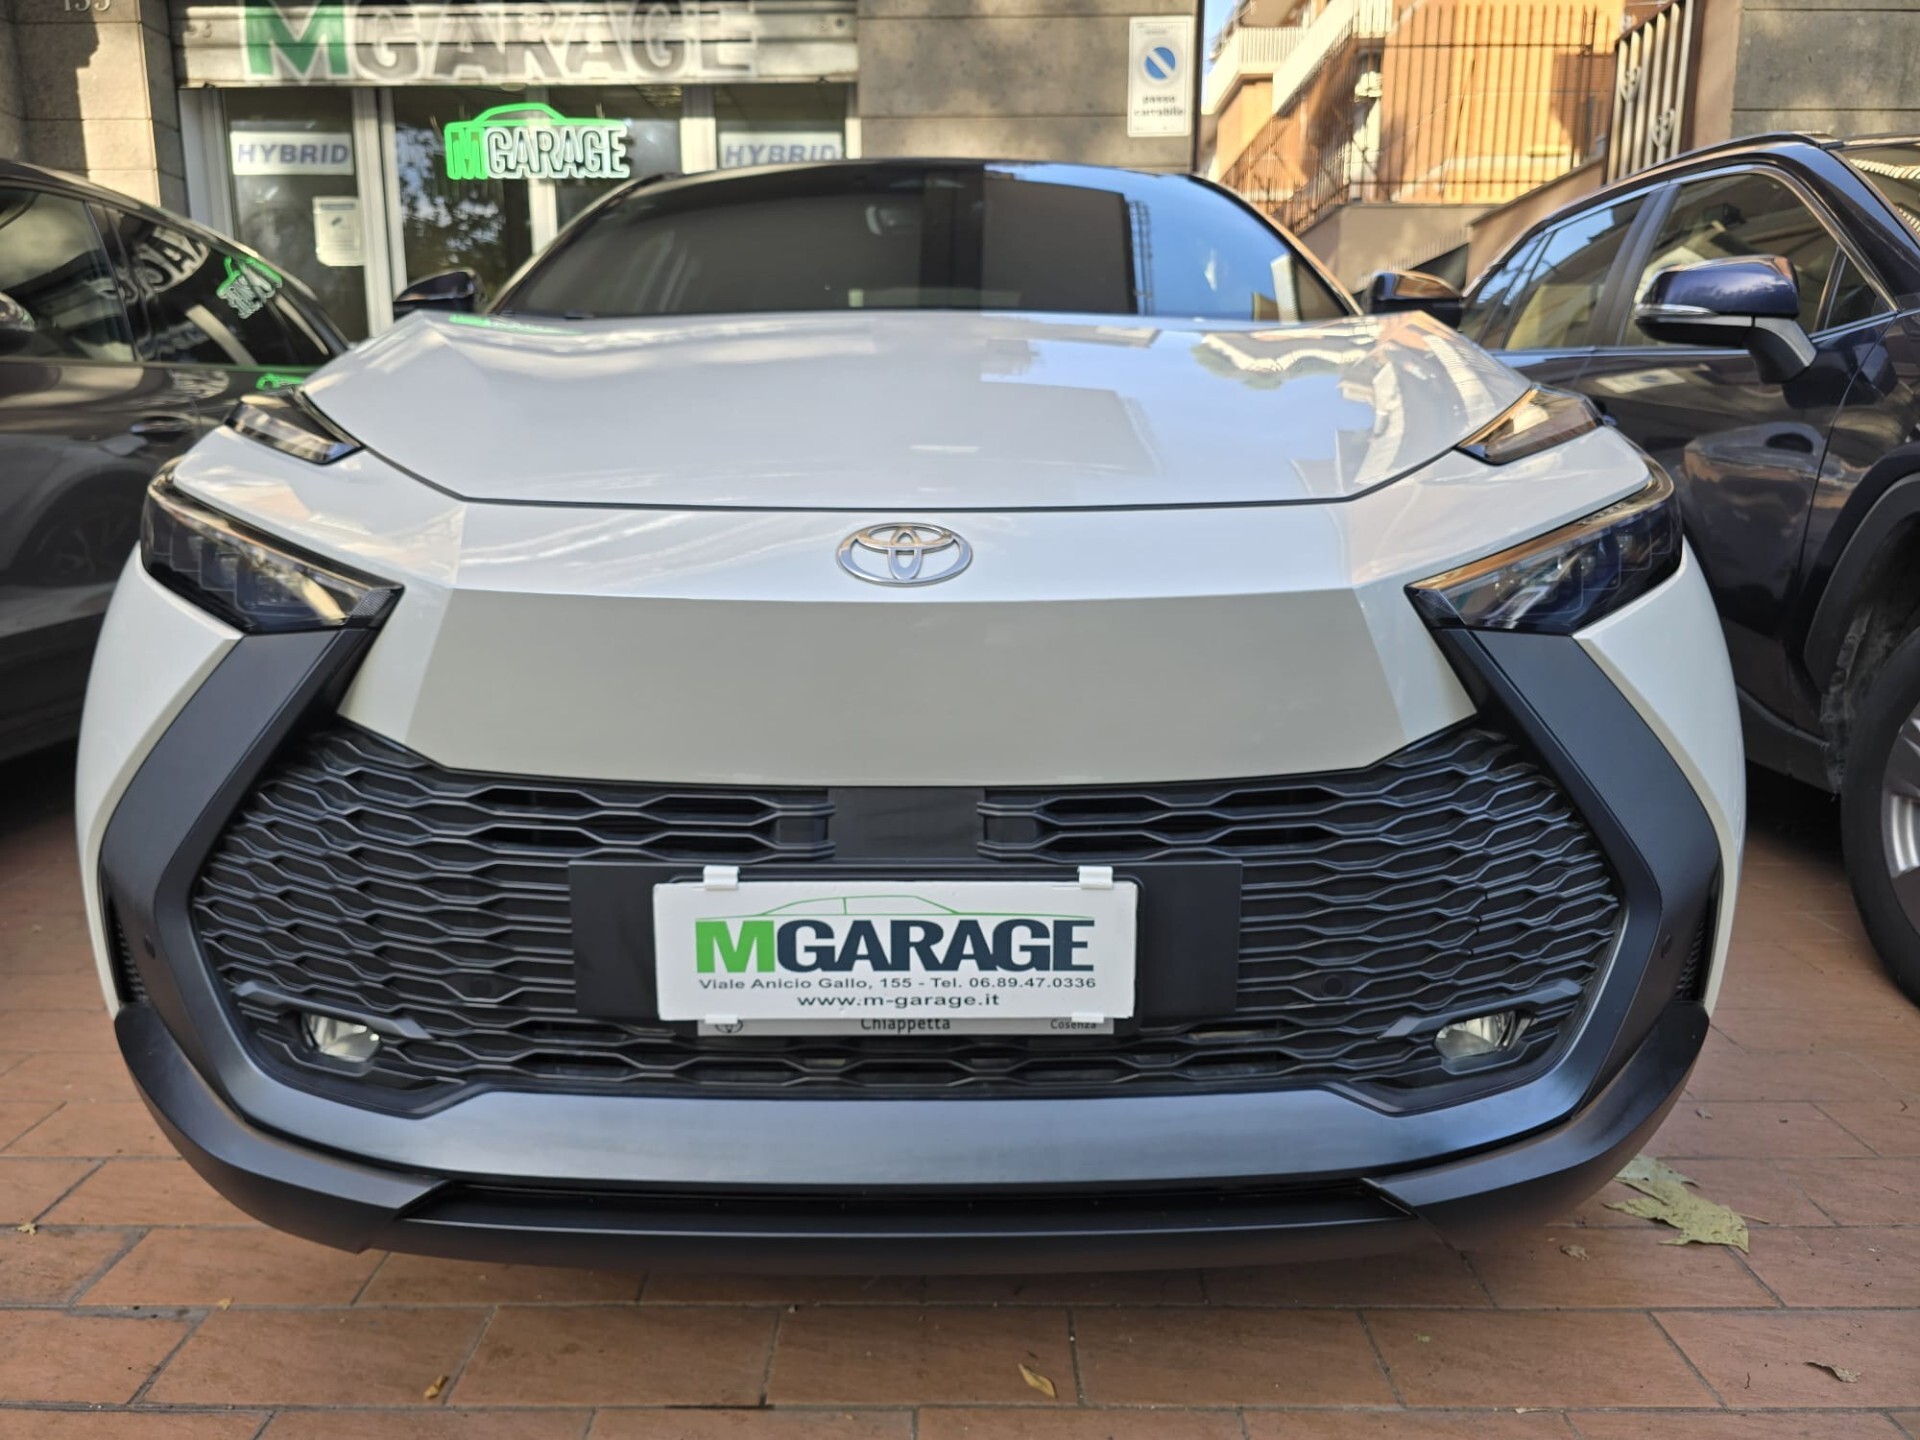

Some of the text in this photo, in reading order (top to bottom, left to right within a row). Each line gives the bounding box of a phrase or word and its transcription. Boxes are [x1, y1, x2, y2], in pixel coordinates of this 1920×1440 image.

[237, 143, 350, 165] HYBRID
[446, 125, 630, 180] MGARAGE
[725, 144, 838, 167] HYBRID
[695, 919, 1095, 973] MGARAGE
[699, 978, 746, 990] Viale
[750, 977, 812, 989] Anicio
[818, 976, 873, 990] Gallo,
[880, 978, 912, 988] 155
[930, 977, 962, 988] Tel.
[969, 977, 1096, 988] 06.89.47.0336
[797, 994, 1000, 1008] www.m-garage.it
[860, 1018, 951, 1033] Chiappetta
